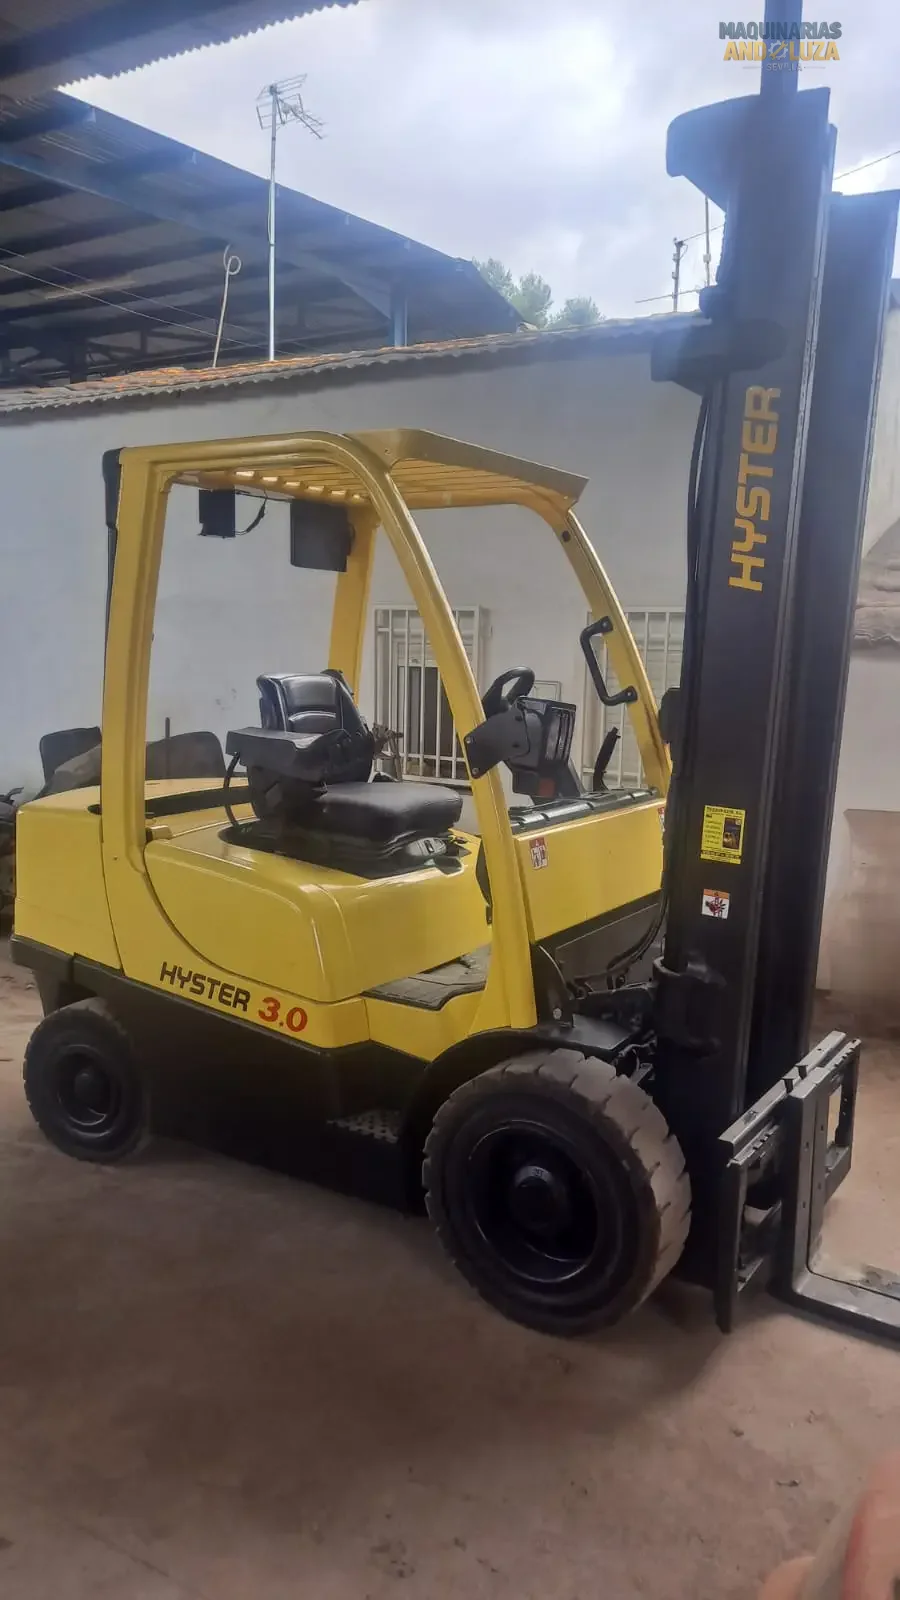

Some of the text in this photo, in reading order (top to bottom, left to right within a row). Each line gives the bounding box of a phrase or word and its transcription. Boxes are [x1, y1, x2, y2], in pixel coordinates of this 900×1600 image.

[728, 385, 781, 591] HYSTER
[160, 961, 308, 1033] HYSTER 3.0
